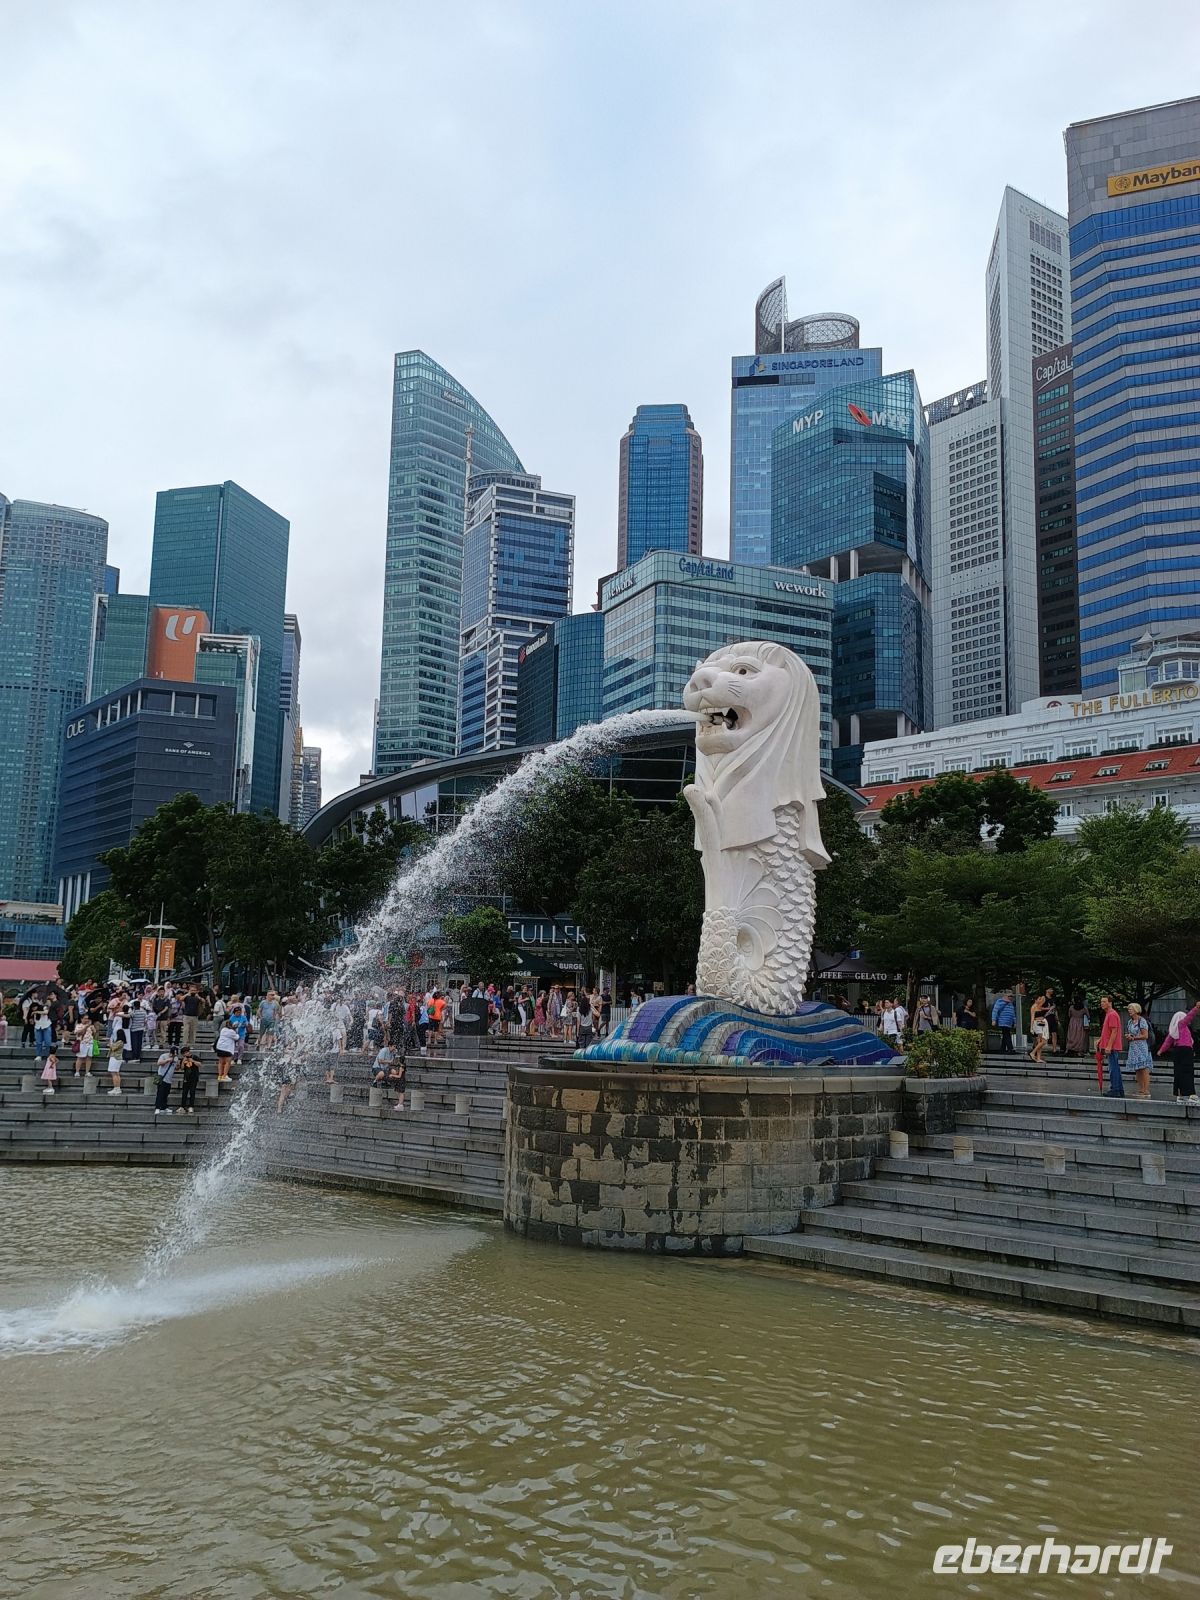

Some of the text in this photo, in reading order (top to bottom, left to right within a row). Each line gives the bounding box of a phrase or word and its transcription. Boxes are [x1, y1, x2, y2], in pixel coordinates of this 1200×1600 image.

[792, 409, 824, 435] MYP
[678, 557, 734, 581] CapitaLand
[774, 580, 827, 598] wework
[1071, 700, 1103, 717] THE
[66, 718, 86, 739] OUE
[854, 972, 887, 981] GELATO
